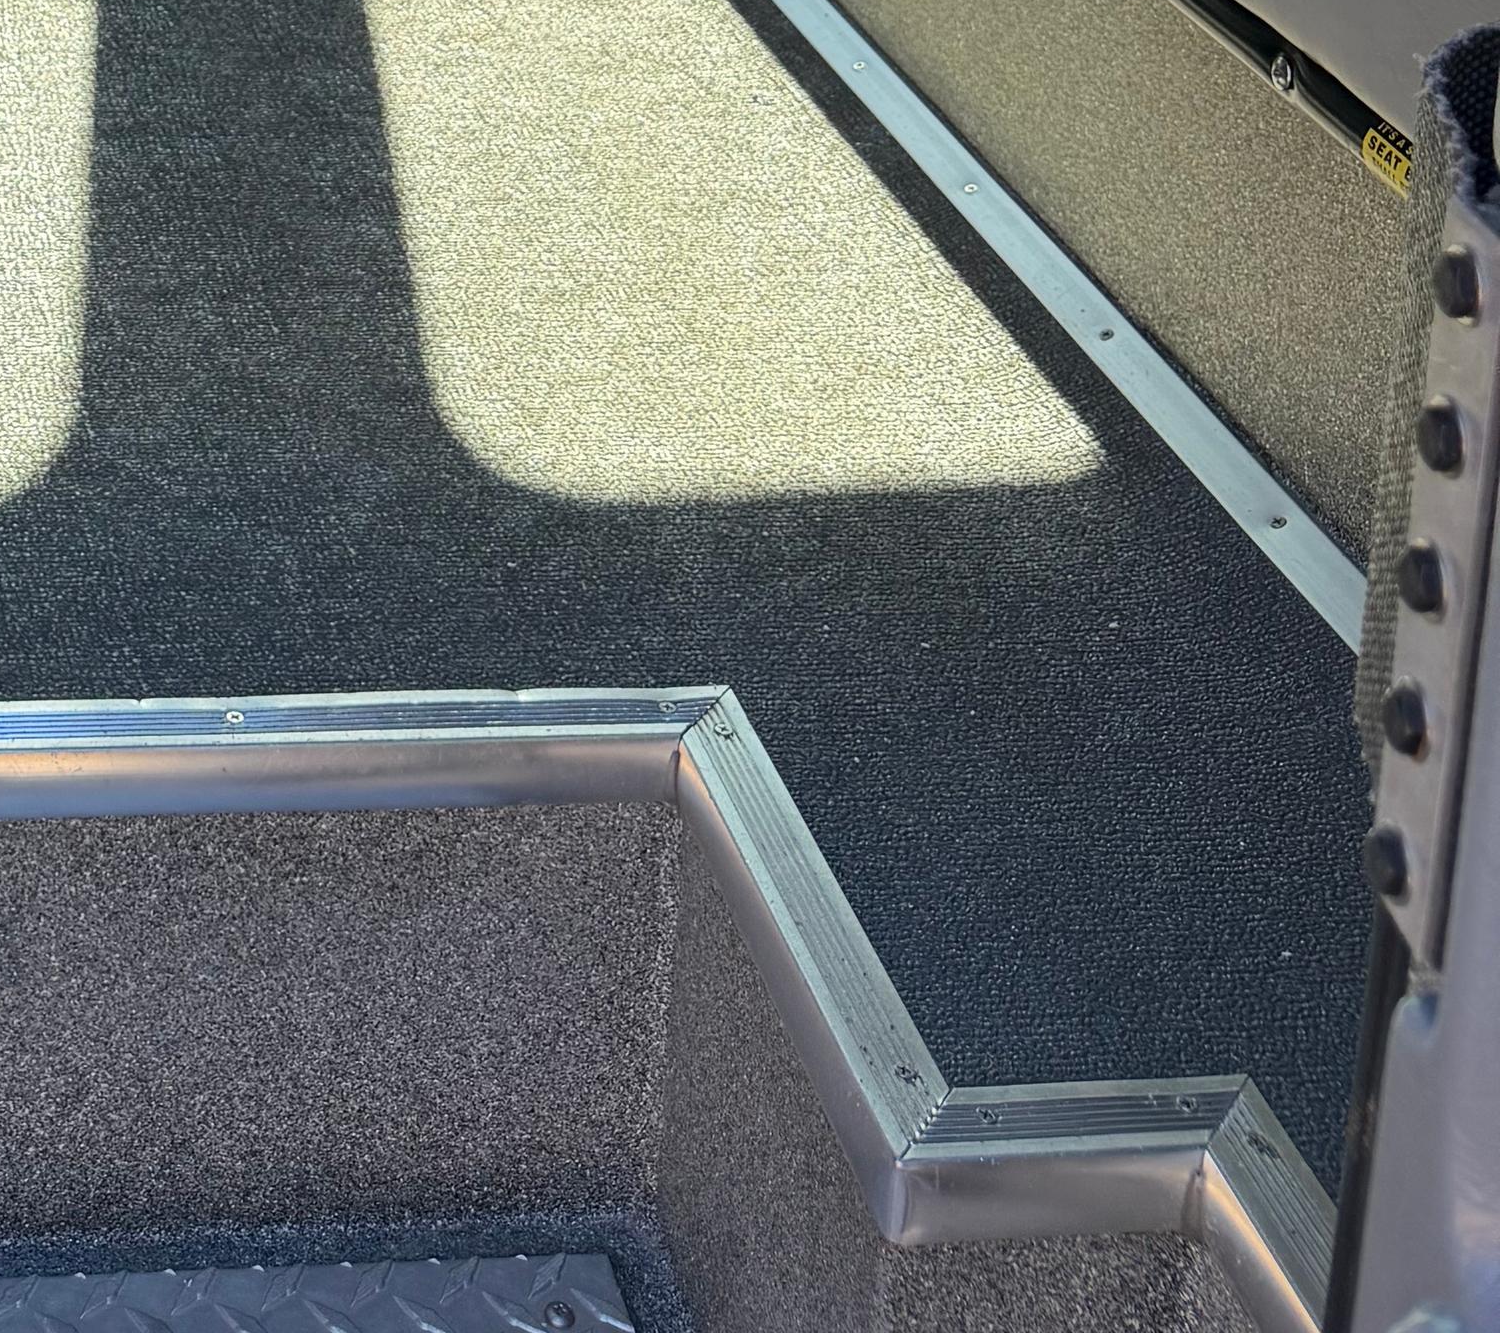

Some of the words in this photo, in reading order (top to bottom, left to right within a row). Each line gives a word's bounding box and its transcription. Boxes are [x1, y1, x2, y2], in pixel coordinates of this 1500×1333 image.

[1377, 121, 1399, 140] IT'S
[1396, 139, 1406, 149] A
[1367, 135, 1402, 171] SEAT
